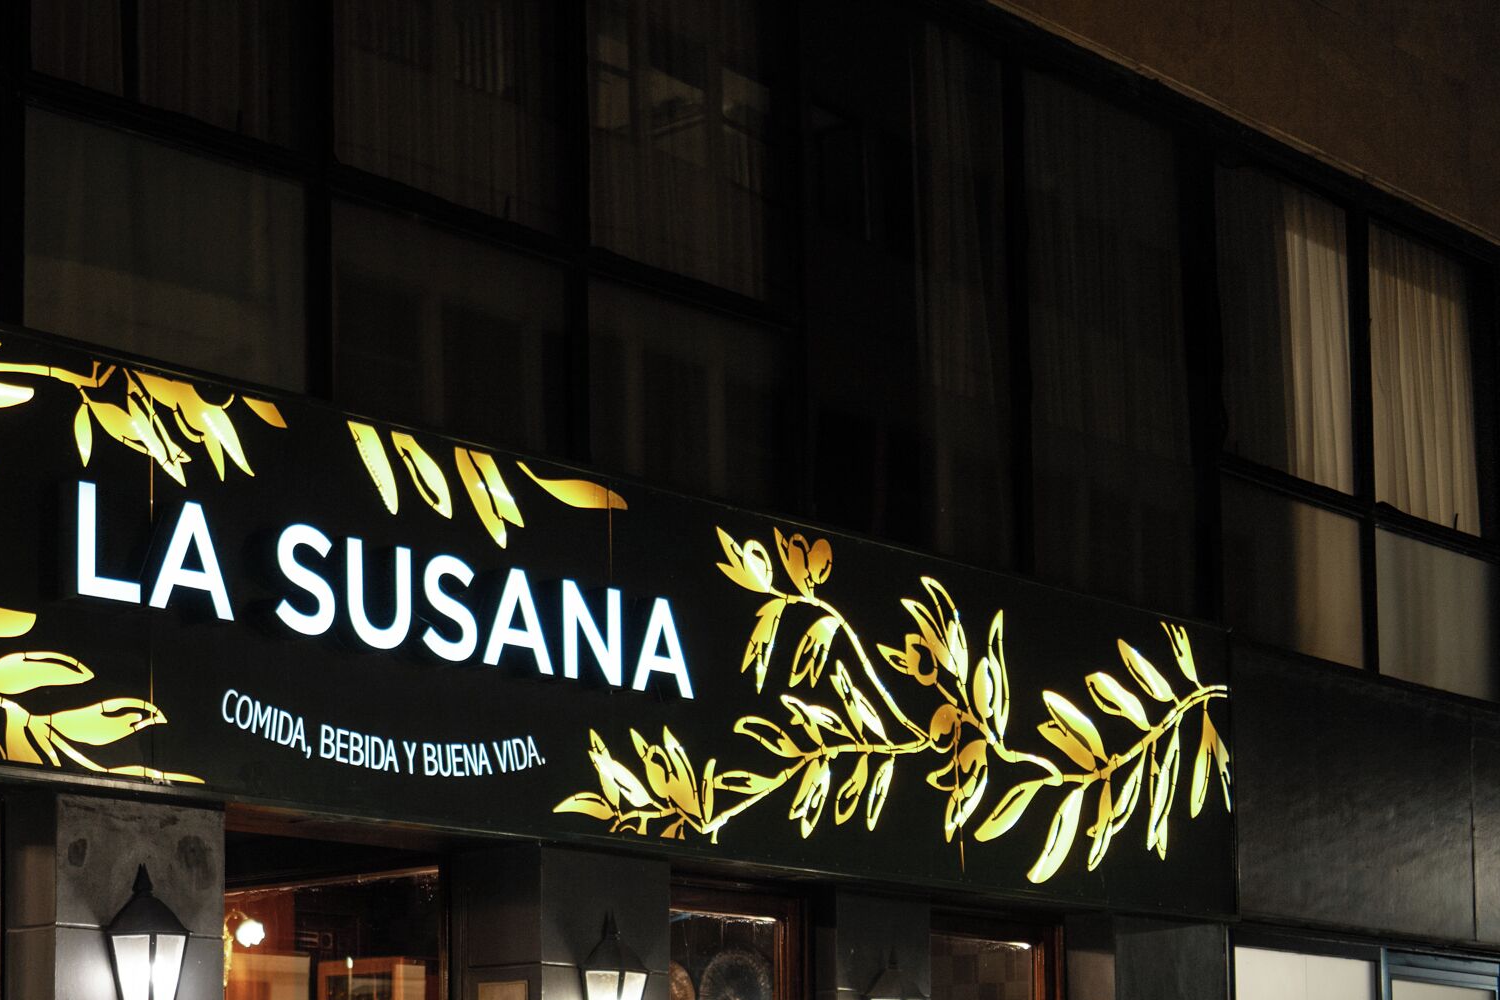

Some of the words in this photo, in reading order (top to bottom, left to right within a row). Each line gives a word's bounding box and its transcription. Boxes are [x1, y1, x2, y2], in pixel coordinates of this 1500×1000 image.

[77, 481, 234, 621] LA
[275, 524, 694, 700] SUSANA
[221, 689, 312, 759] COMIDA,
[319, 724, 400, 773] BEBIDA
[402, 740, 417, 775] Y
[422, 742, 493, 778] BUENA
[492, 735, 546, 774] VIDA.
